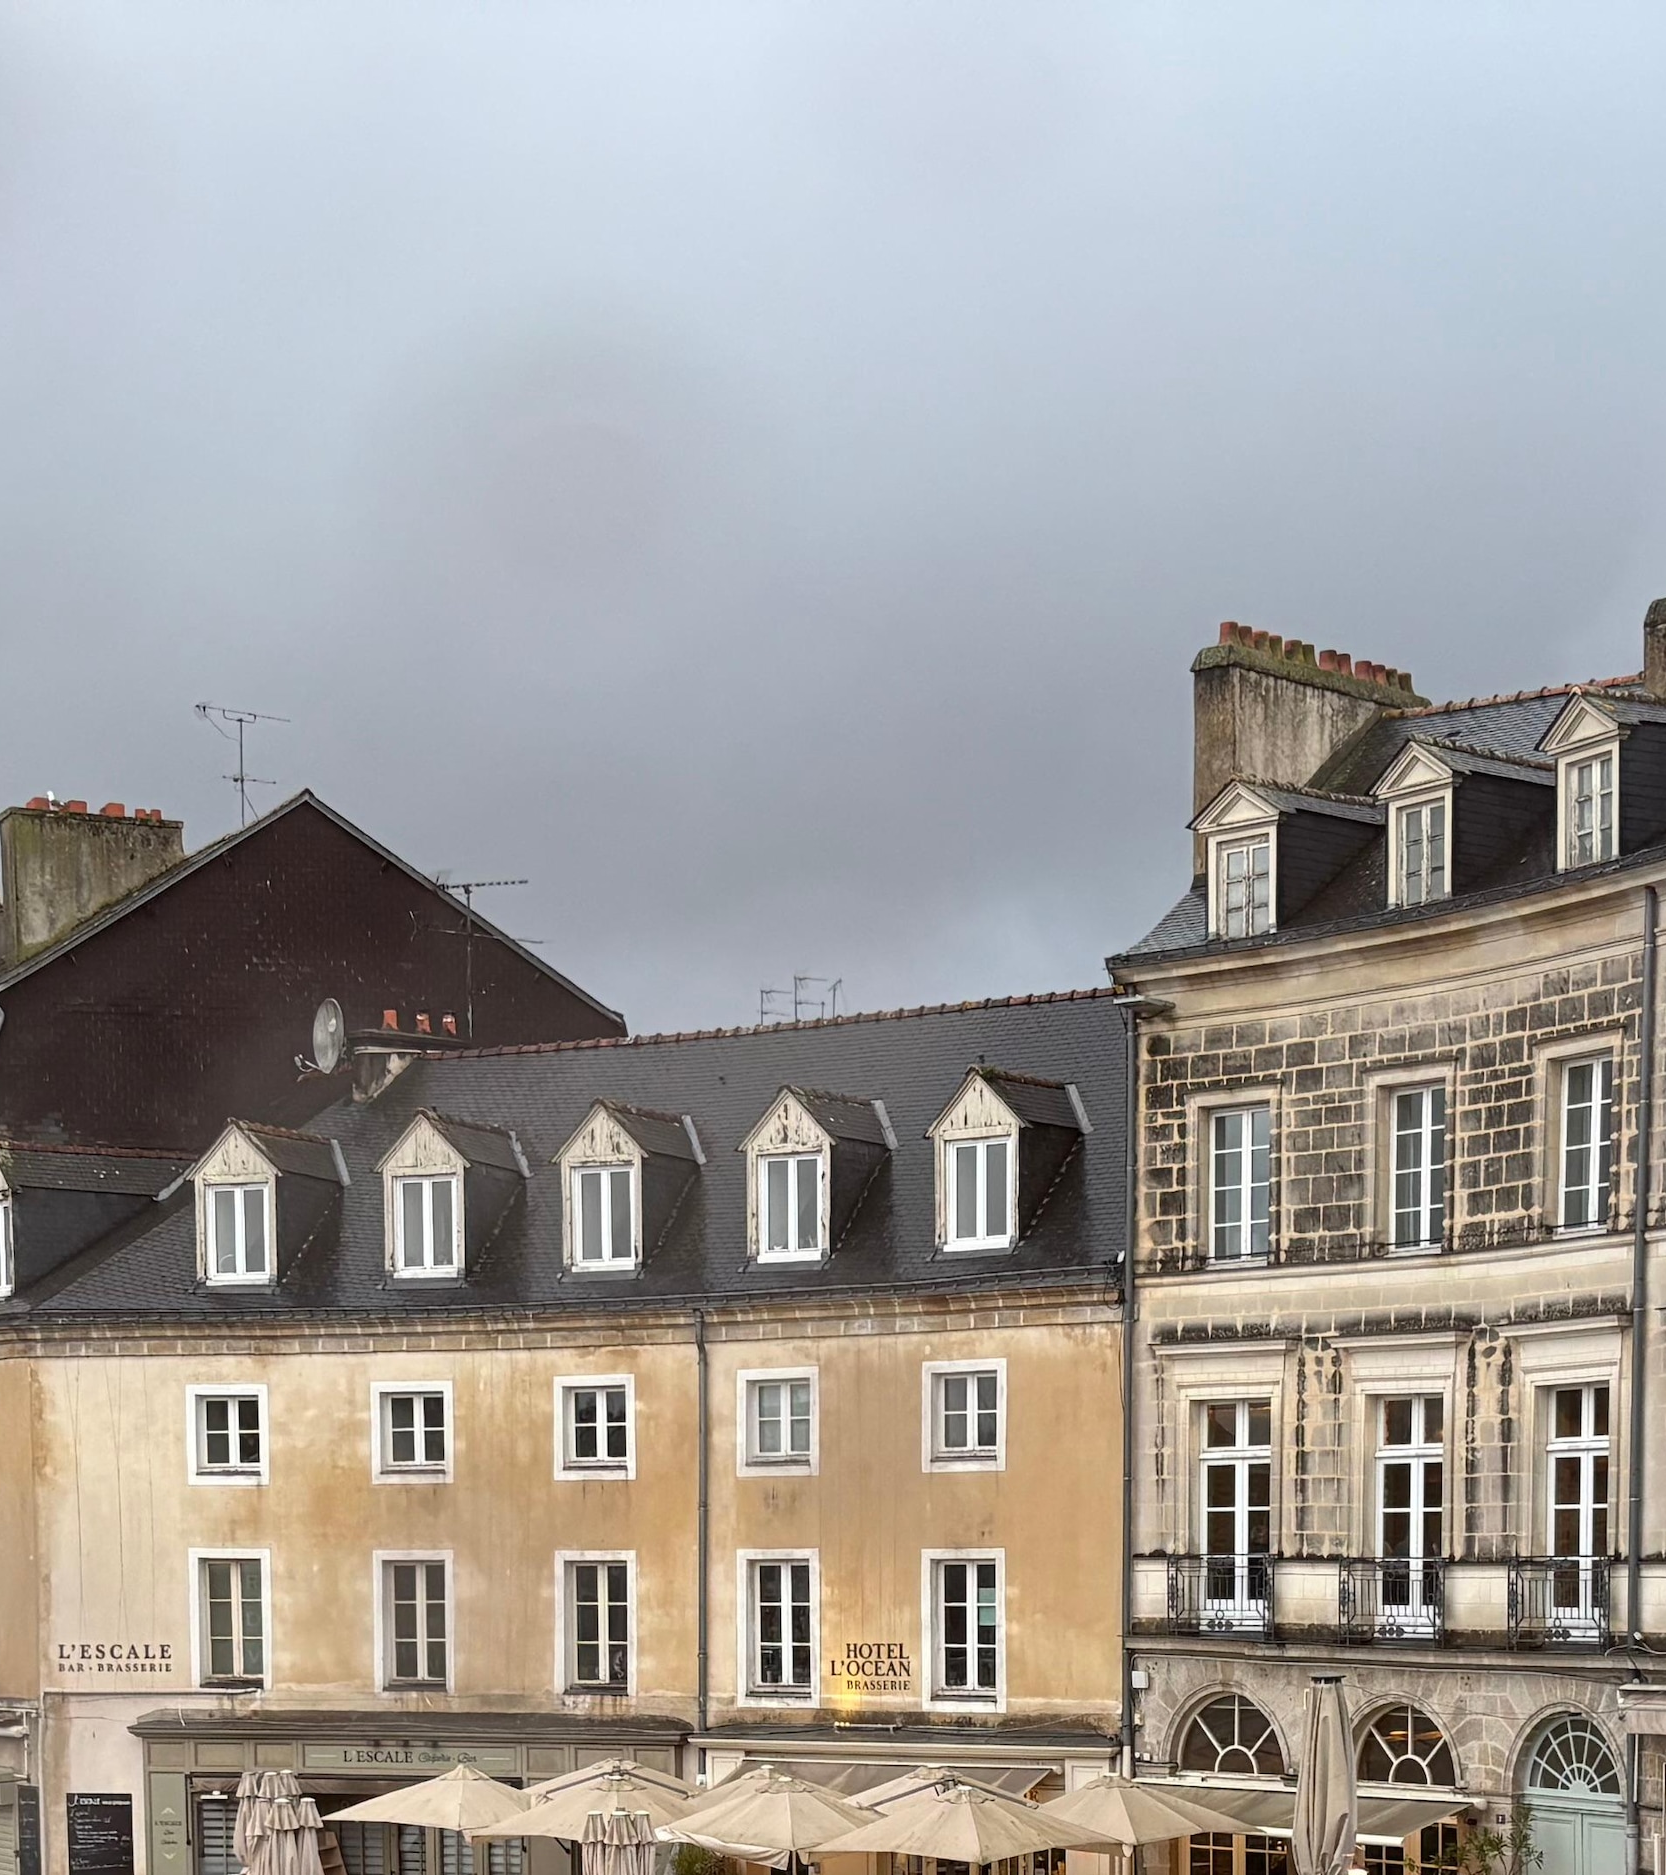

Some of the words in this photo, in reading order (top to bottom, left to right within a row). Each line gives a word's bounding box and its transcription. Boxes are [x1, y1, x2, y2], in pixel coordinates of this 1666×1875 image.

[58, 1644, 172, 1660] L'ESCALE
[846, 1643, 910, 1659] HOTEL
[58, 1663, 85, 1673] BAR
[97, 1663, 172, 1673] BRASSERIE
[831, 1660, 911, 1677] L'OCEAN
[847, 1680, 911, 1691] BRASSERIE
